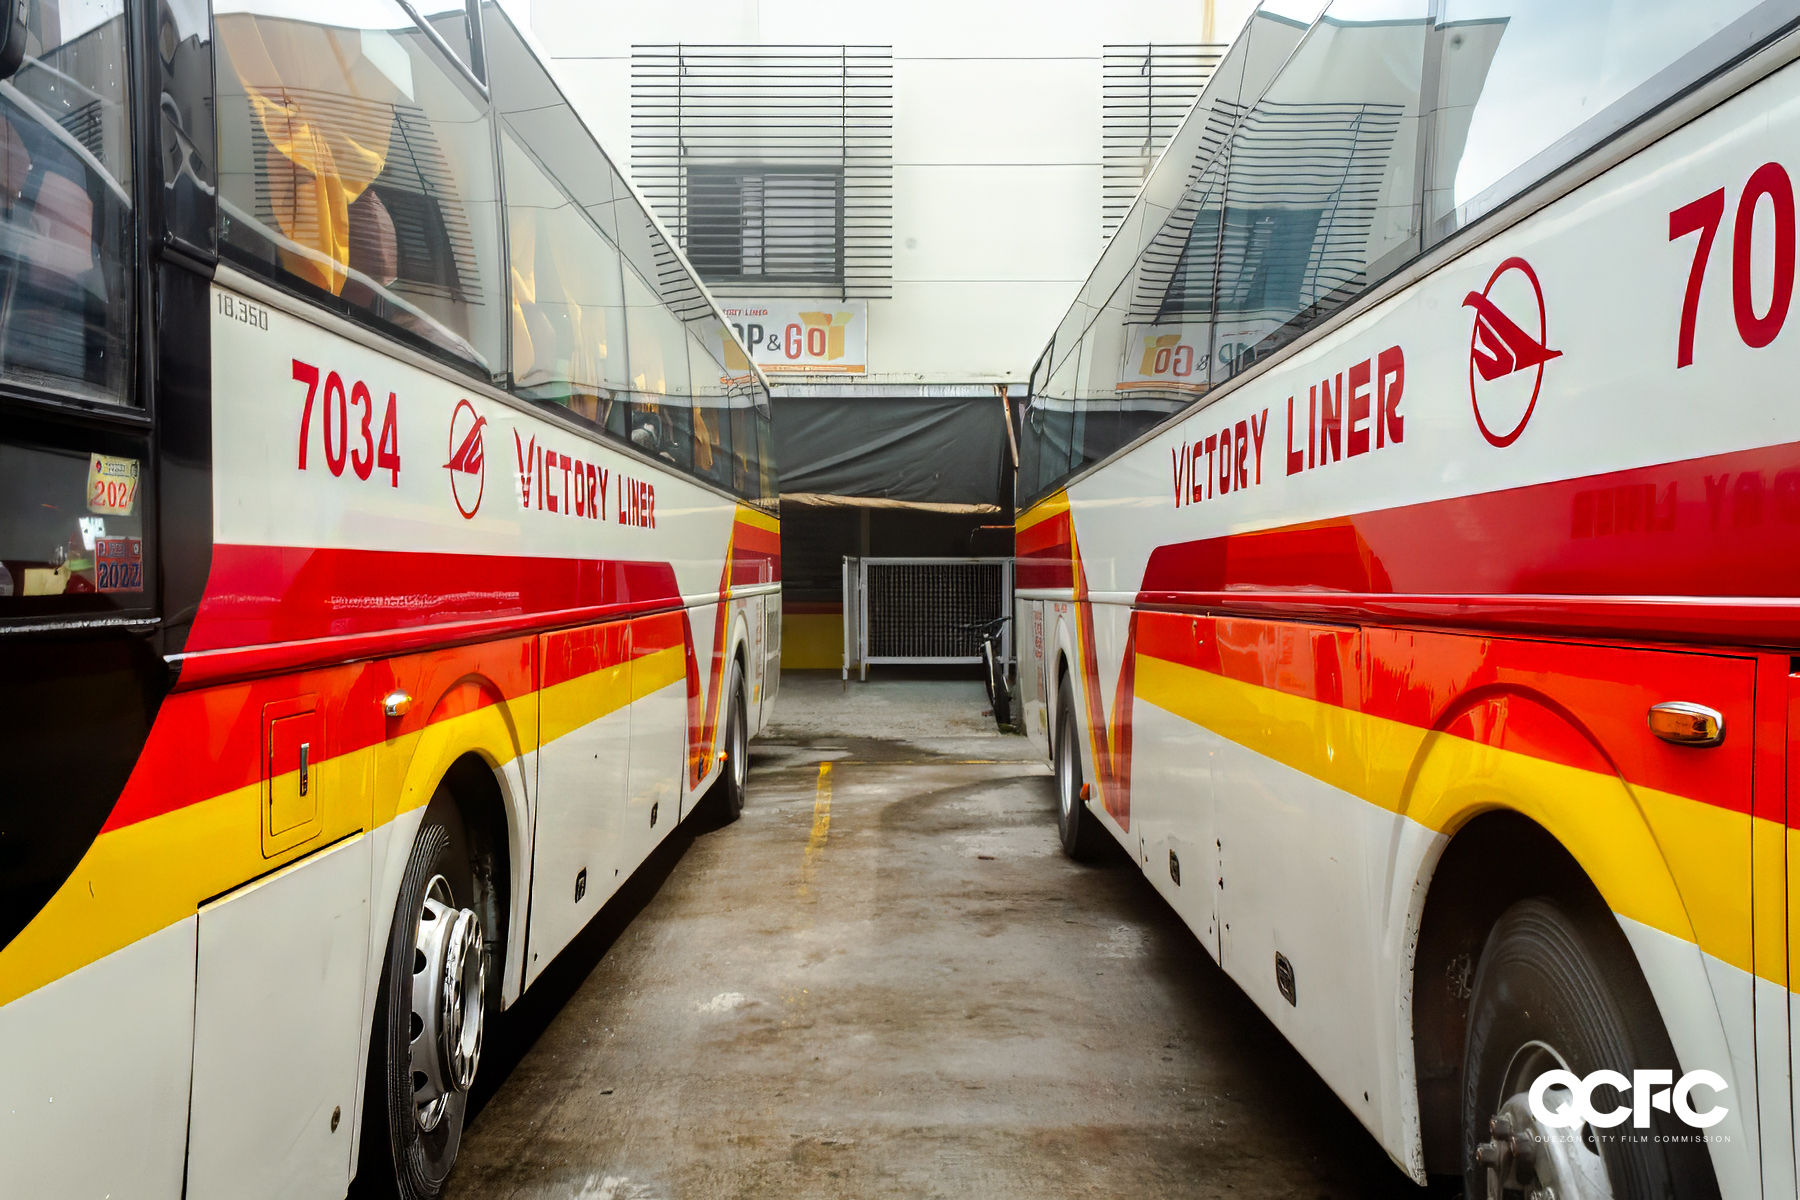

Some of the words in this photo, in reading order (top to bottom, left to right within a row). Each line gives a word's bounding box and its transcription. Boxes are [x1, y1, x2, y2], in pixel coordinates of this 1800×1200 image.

[1669, 162, 1796, 369] 70
[767, 334, 781, 351] &
[785, 323, 826, 360] GO
[292, 358, 400, 488] 7034
[513, 427, 608, 521] VICTORY
[618, 474, 655, 529] LINER
[1172, 408, 1268, 508] VICTORY
[1287, 345, 1404, 476] LINER
